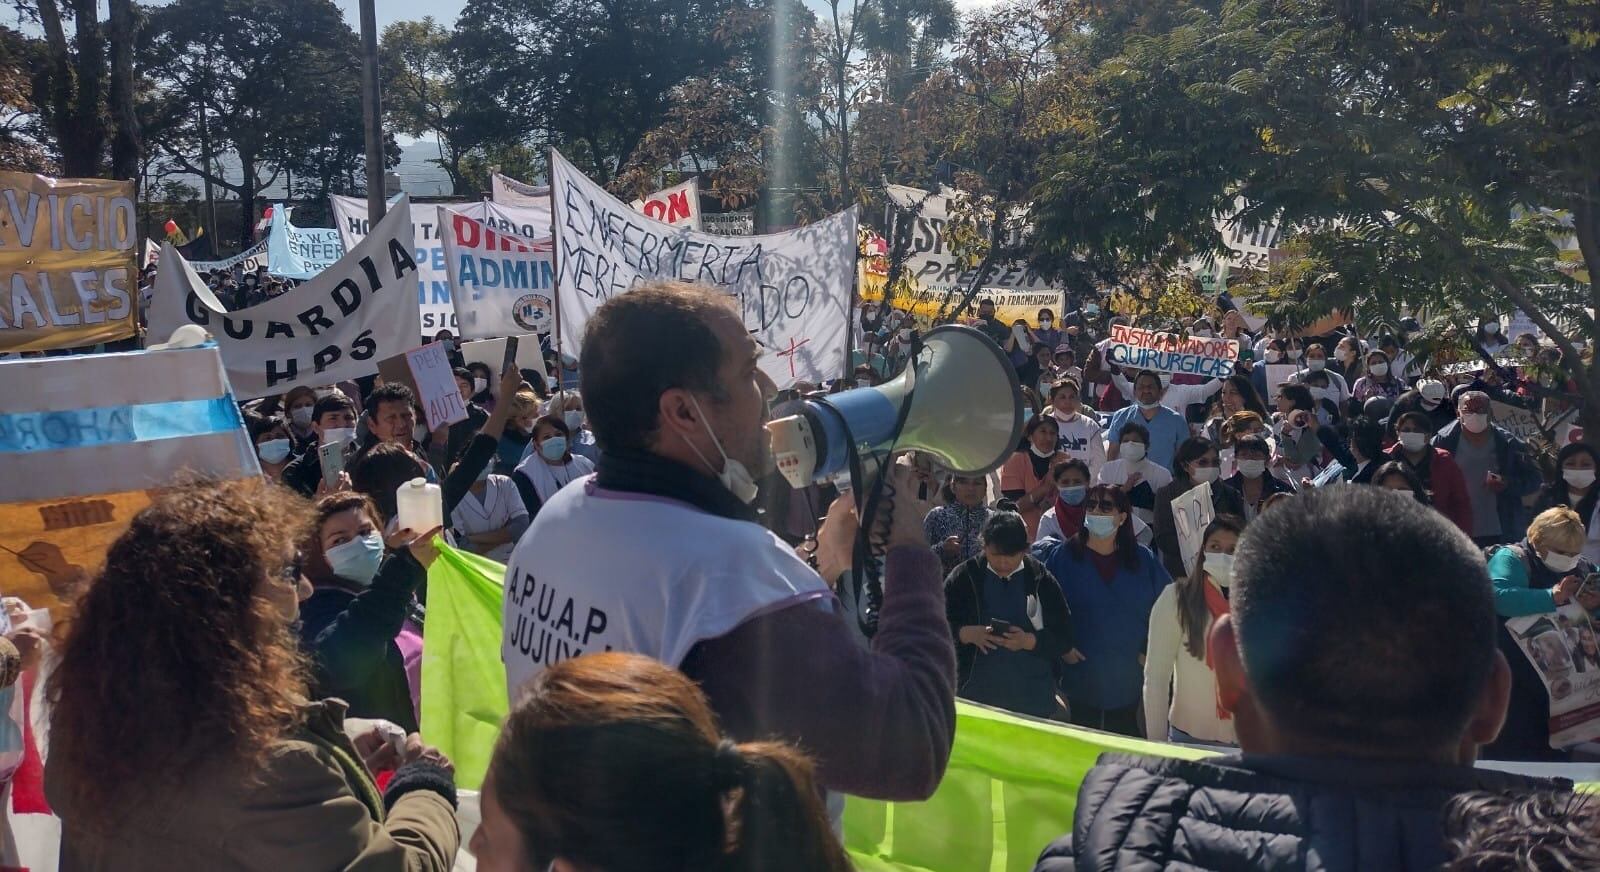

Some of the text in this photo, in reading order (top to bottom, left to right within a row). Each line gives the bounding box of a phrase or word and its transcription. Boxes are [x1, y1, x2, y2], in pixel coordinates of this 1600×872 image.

[0, 189, 137, 252] VICIO
[566, 180, 763, 286] ENFERMERIA
[0, 267, 131, 329] ALES
[186, 238, 418, 340] GUARDIA
[266, 328, 377, 388] HPS
[1111, 325, 1238, 359] INSTRUMENTADORAS
[1113, 344, 1235, 377] QUIRURGICAS
